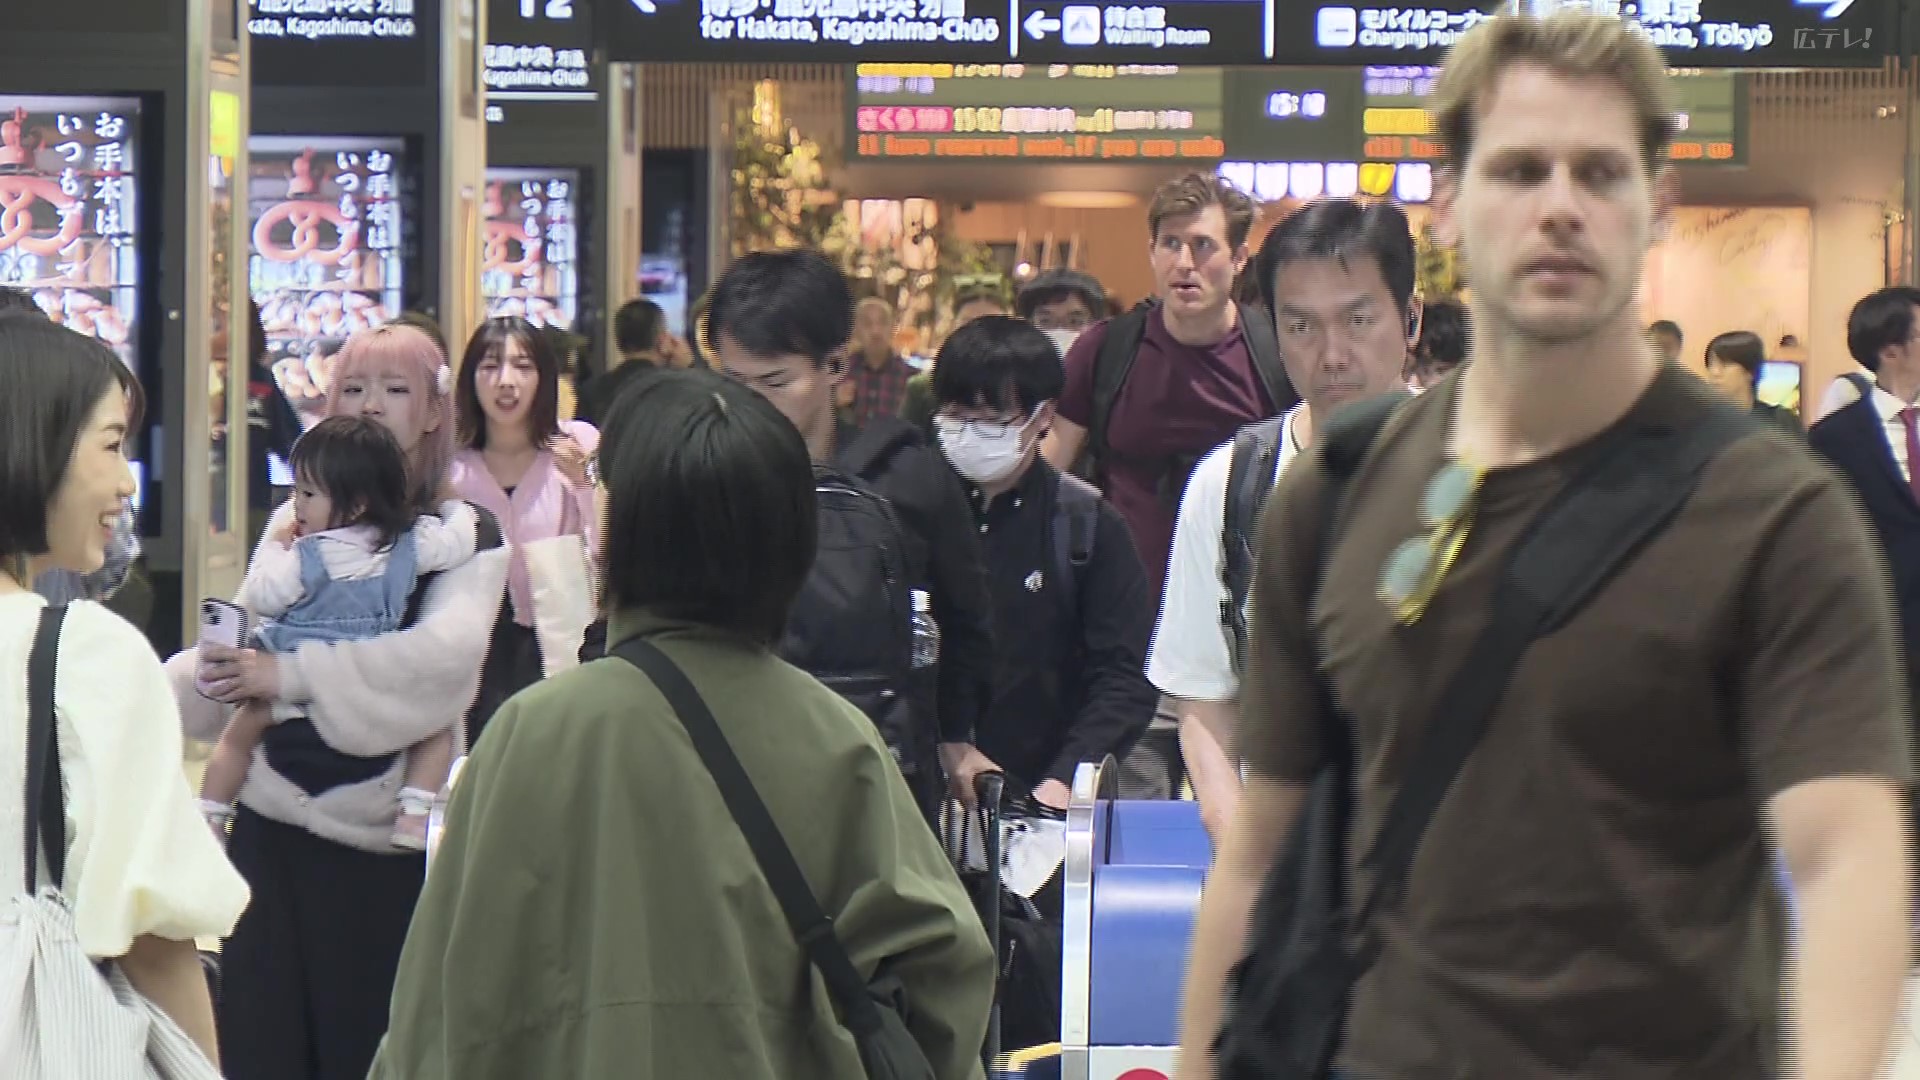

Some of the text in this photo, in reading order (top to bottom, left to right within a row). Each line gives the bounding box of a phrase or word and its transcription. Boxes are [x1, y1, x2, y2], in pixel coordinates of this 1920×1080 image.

[700, 15, 1000, 45] for Hakata, Kagoshima-Chūō
[1702, 24, 1773, 50] Tōkyō
